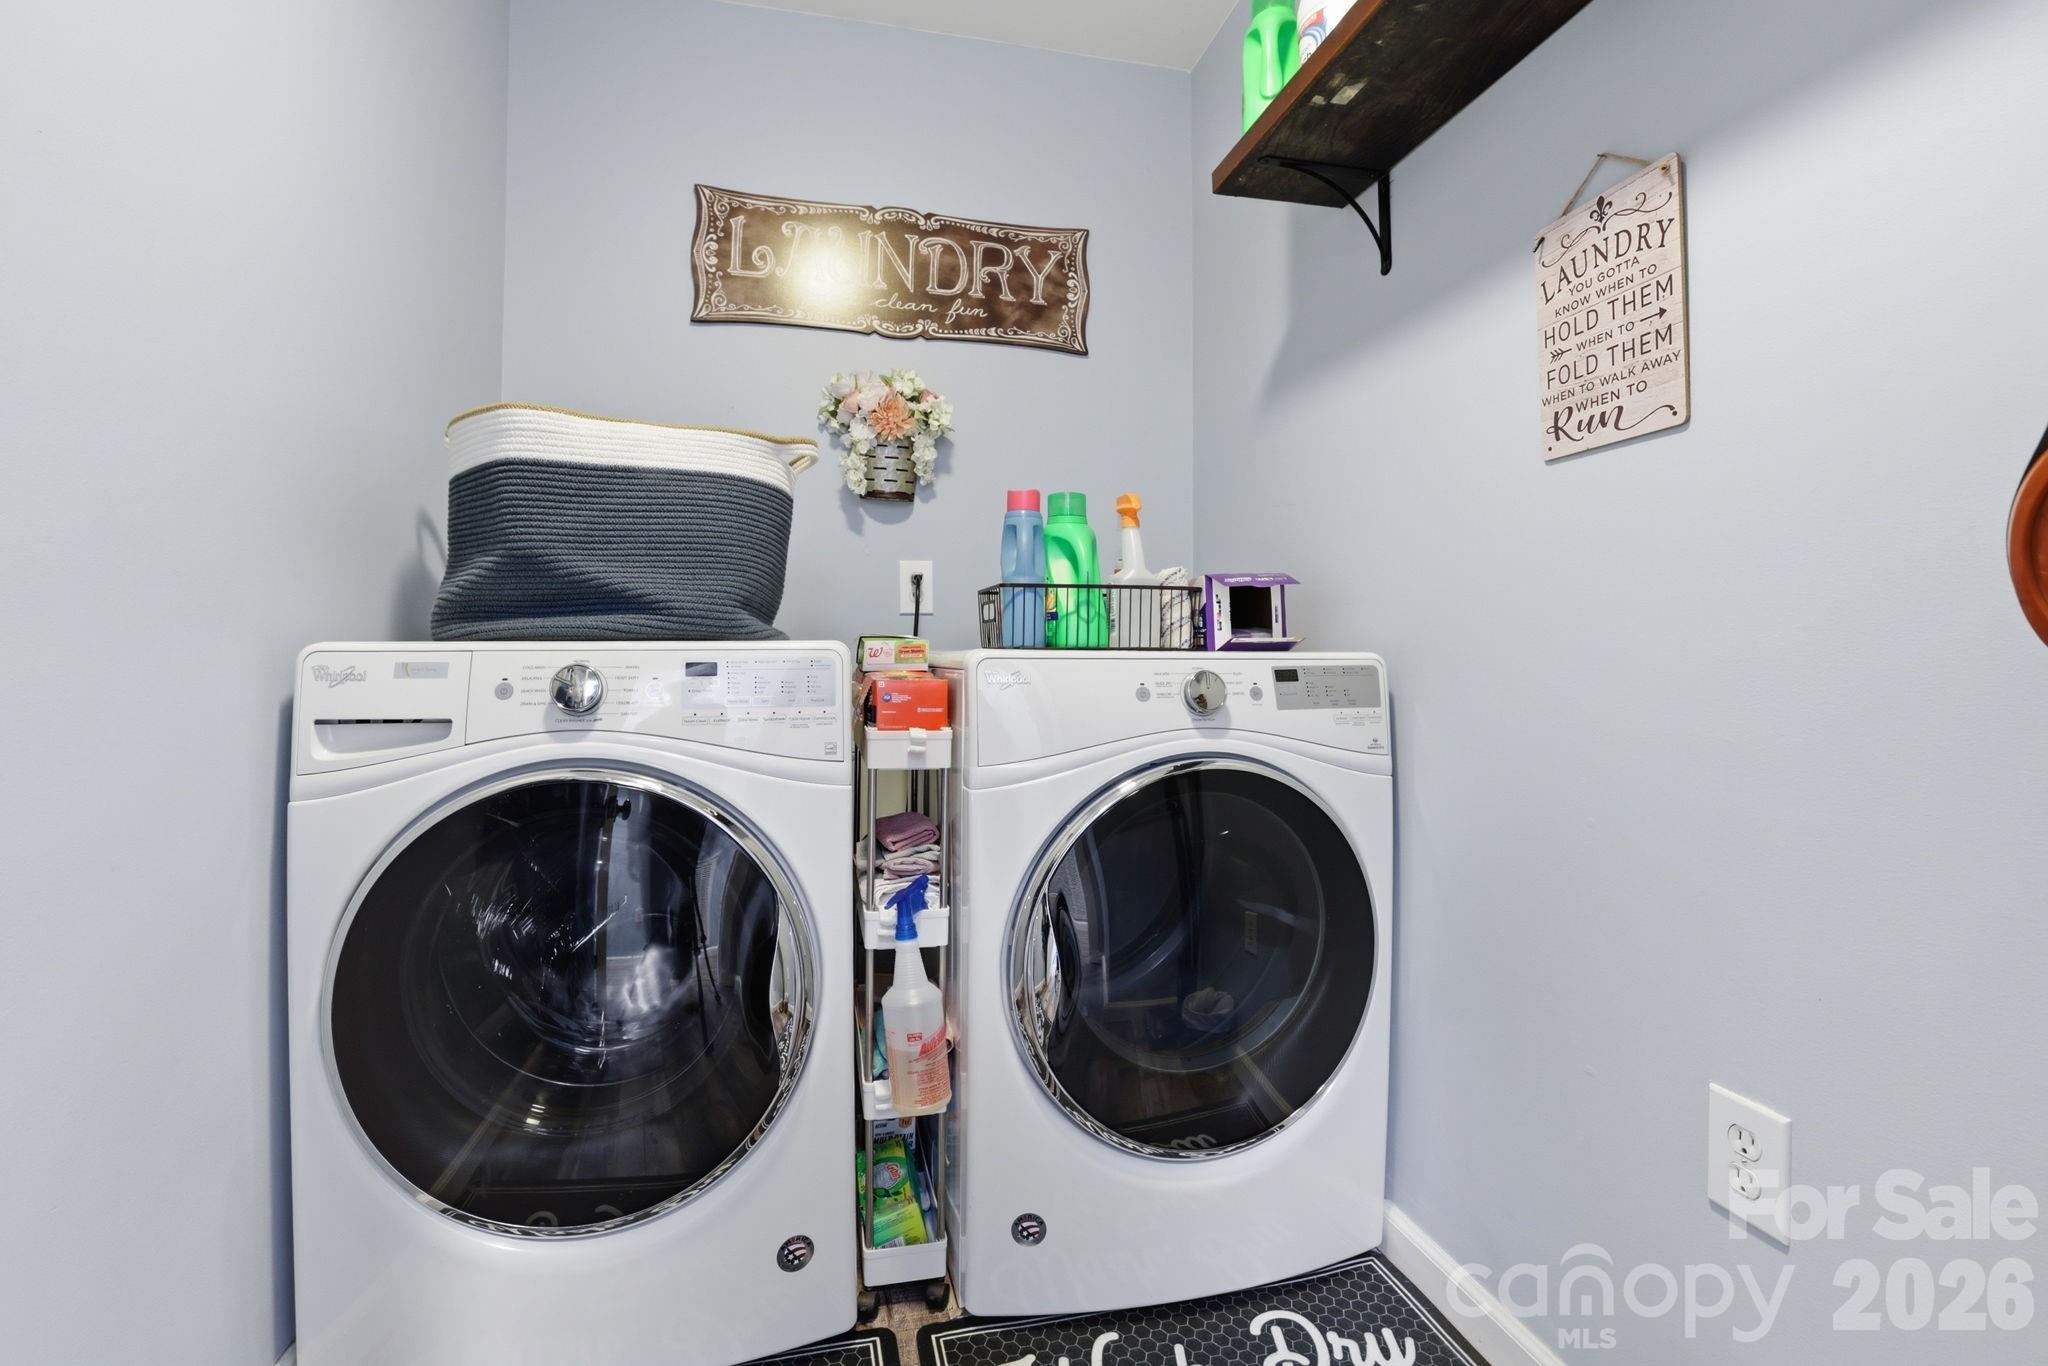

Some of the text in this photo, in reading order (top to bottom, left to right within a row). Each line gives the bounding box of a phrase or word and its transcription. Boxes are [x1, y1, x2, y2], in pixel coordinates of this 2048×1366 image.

[1541, 218, 1675, 305] LAUNDRY
[1569, 256, 1640, 296] YOU GOTTA
[870, 292, 990, 325] clean fun
[1544, 273, 1673, 349] HOLD THEM
[1555, 263, 1658, 318] KNOW WHEN TO
[1547, 323, 1672, 390] FOLD THEM
[1576, 321, 1635, 352] WHEN TO
[1541, 350, 1681, 407] WHEN TO WALK AWAY
[1575, 379, 1648, 414] WHEN TO
[1546, 405, 1650, 442] Run
